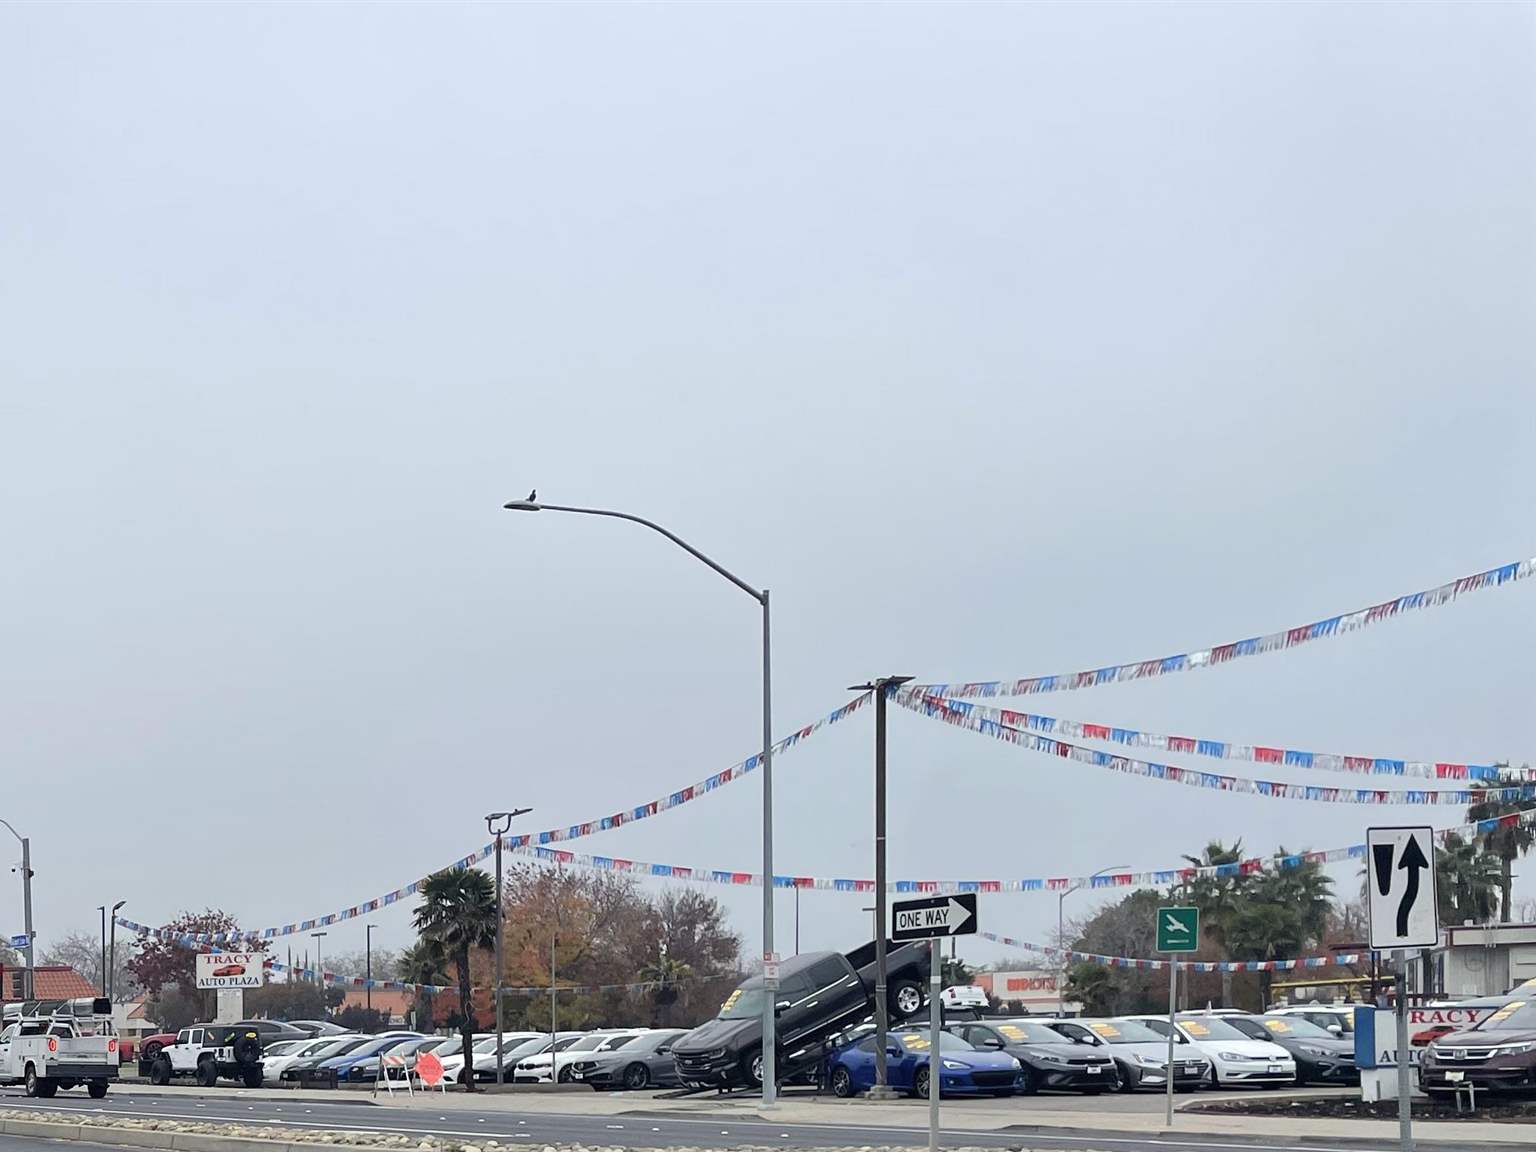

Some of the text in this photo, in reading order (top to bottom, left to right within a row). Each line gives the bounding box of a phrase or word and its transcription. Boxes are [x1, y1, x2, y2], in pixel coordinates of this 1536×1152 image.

[900, 909, 949, 928] ONE WAY
[206, 955, 252, 964] TRACY
[199, 977, 259, 986] AUTO PLAZA
[1393, 1010, 1481, 1023] RACY
